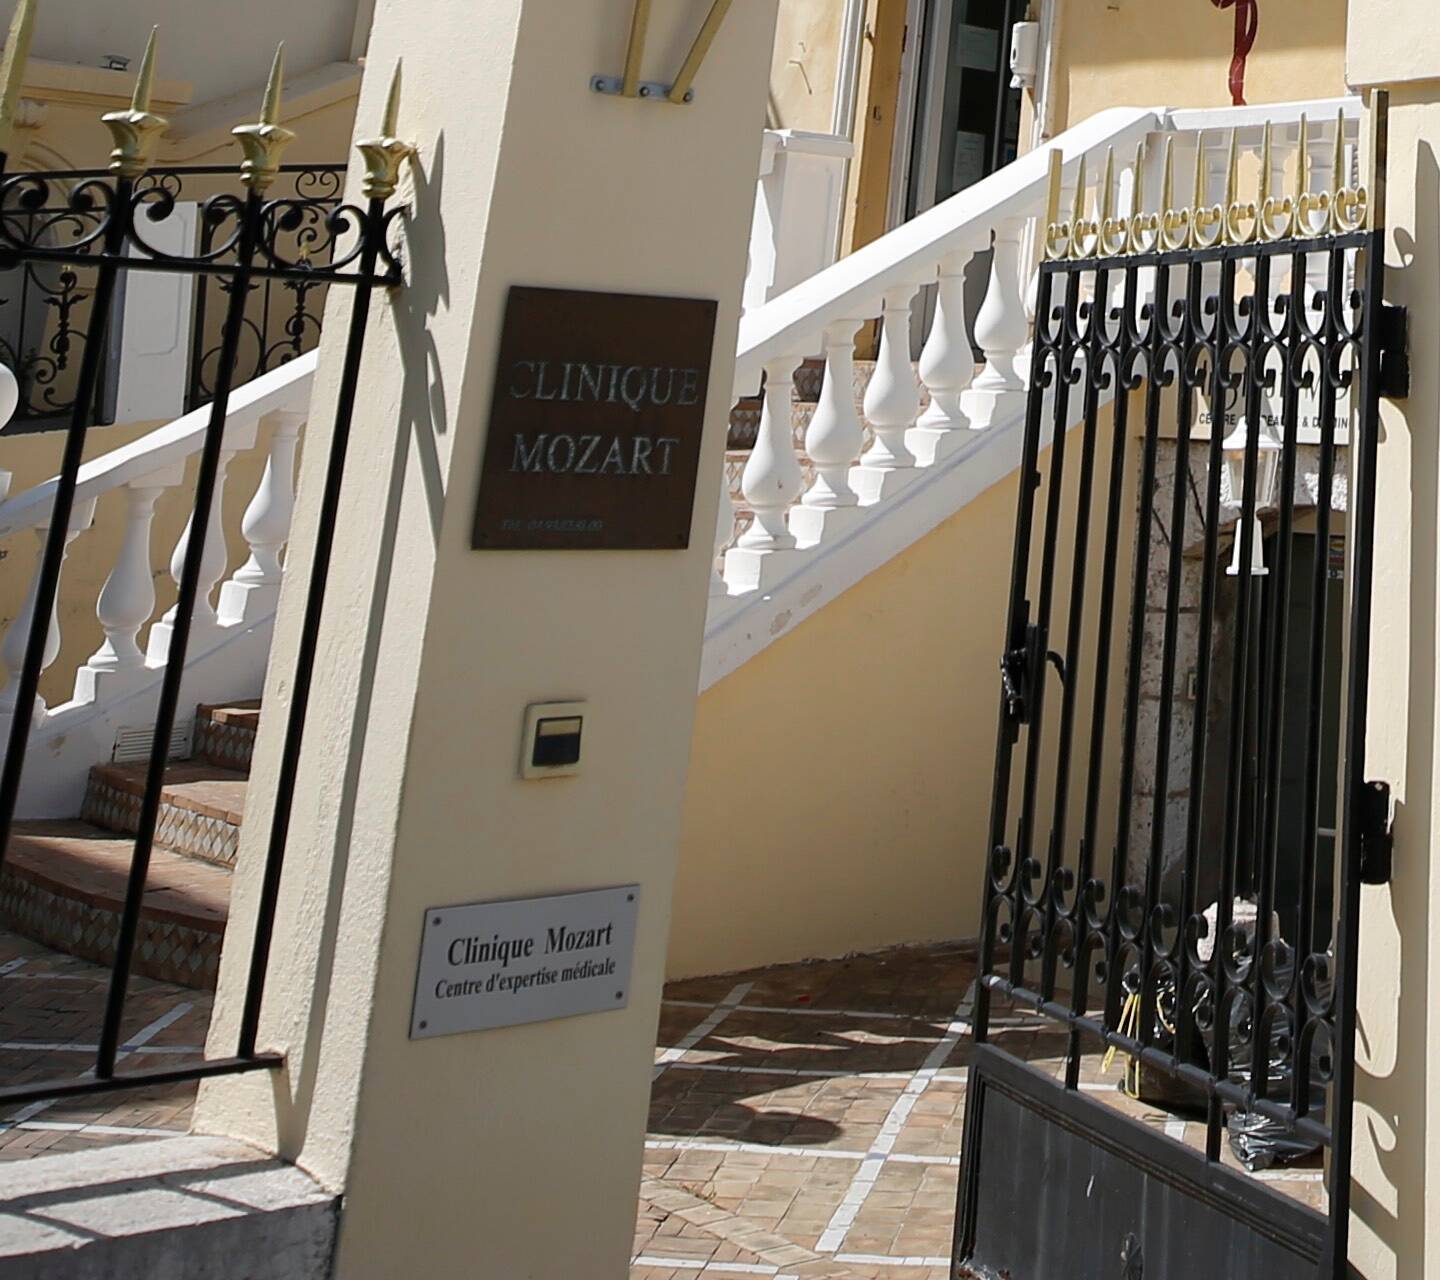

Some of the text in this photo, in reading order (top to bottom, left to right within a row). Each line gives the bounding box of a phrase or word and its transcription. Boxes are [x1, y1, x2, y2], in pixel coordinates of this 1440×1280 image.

[509, 360, 701, 412] CLINIQUE
[1198, 412, 1237, 426] CERE
[509, 433, 680, 475] MOZART
[447, 921, 614, 968] Clinique Mozart
[435, 957, 616, 999] Centre d'expertise médicale
